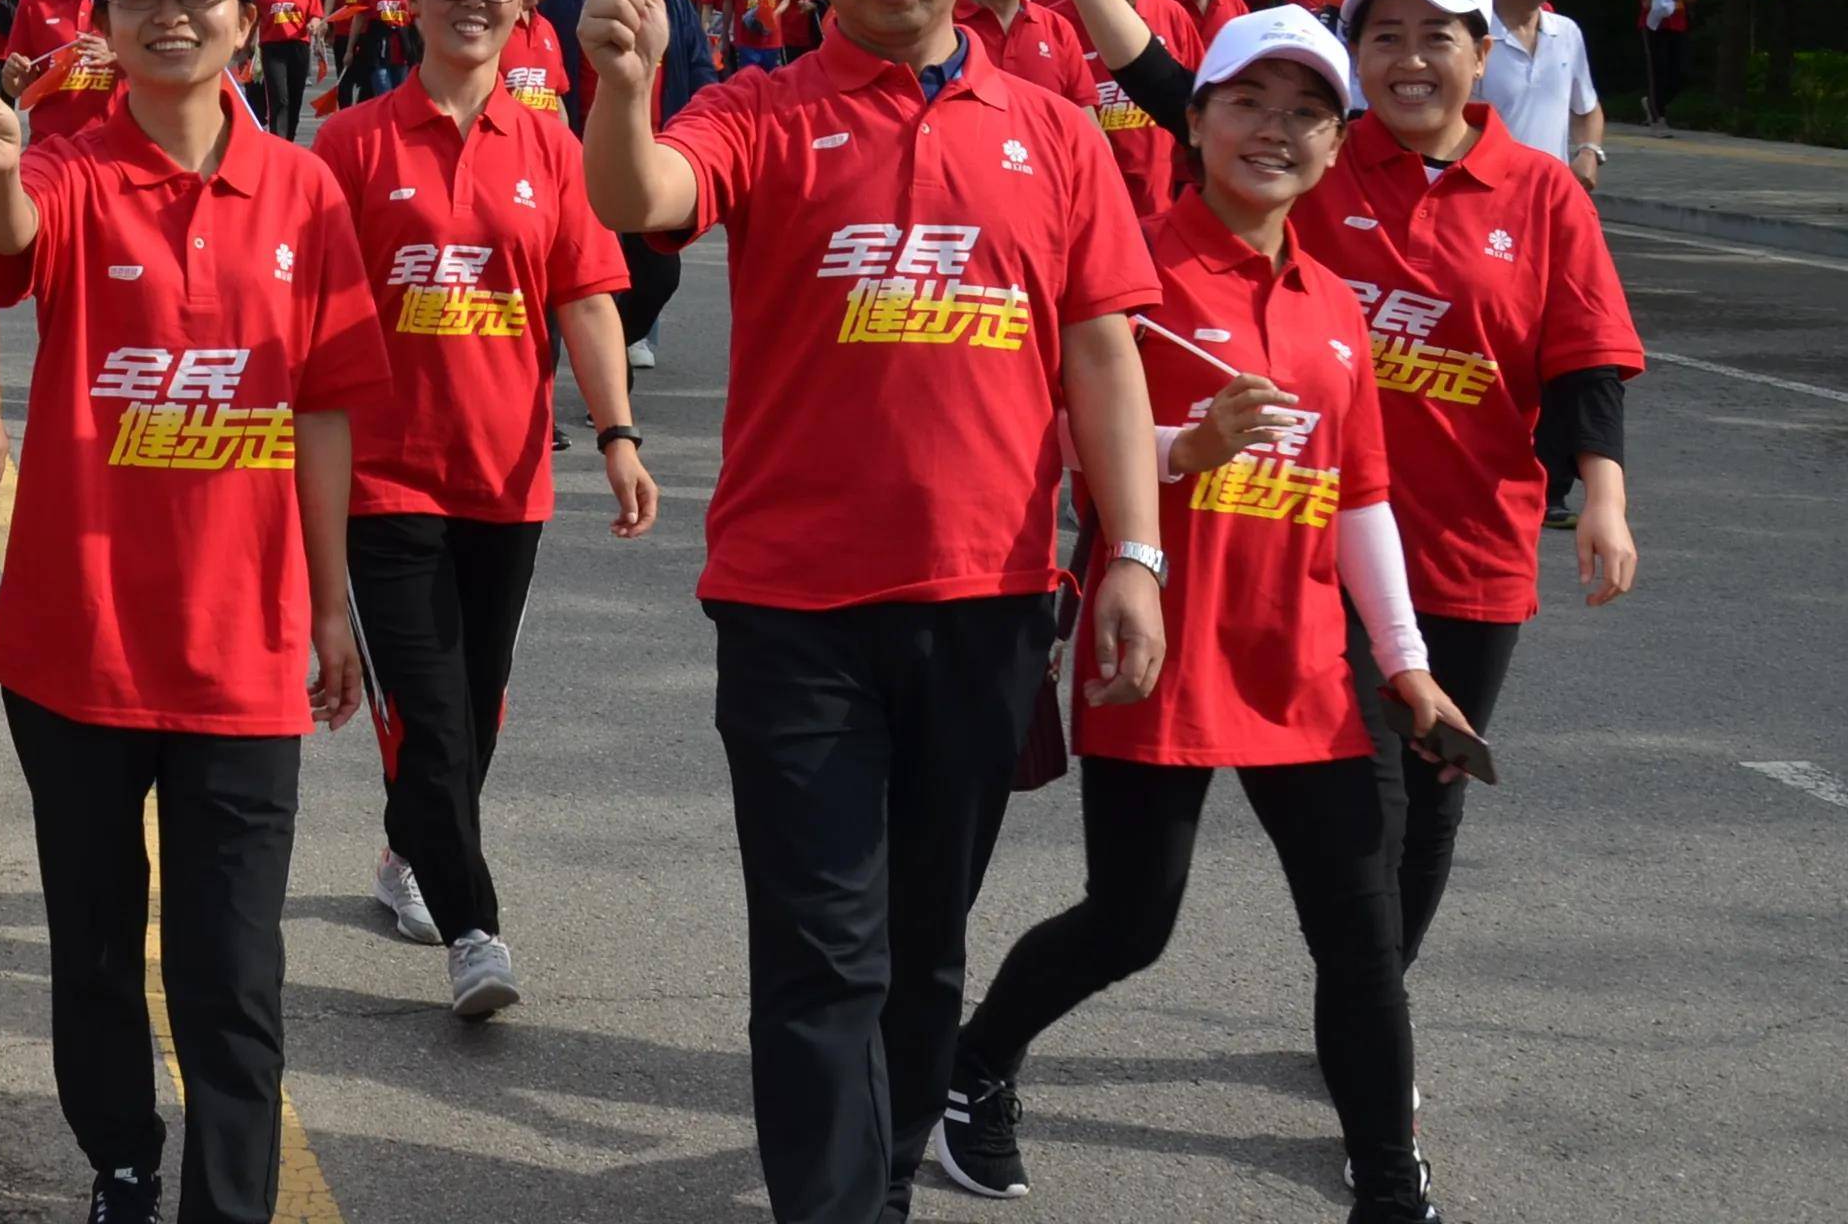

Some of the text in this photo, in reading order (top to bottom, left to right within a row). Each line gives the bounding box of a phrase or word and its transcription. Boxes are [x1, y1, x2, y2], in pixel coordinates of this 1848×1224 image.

[505, 67, 546, 88] 全民
[387, 244, 493, 285] 全民
[817, 223, 981, 277] 全民
[395, 284, 527, 336] 健步走
[837, 276, 1029, 350] 健步走
[90, 347, 250, 399] 全民
[108, 401, 295, 470] 健步走
[1190, 451, 1340, 528] 健步走
